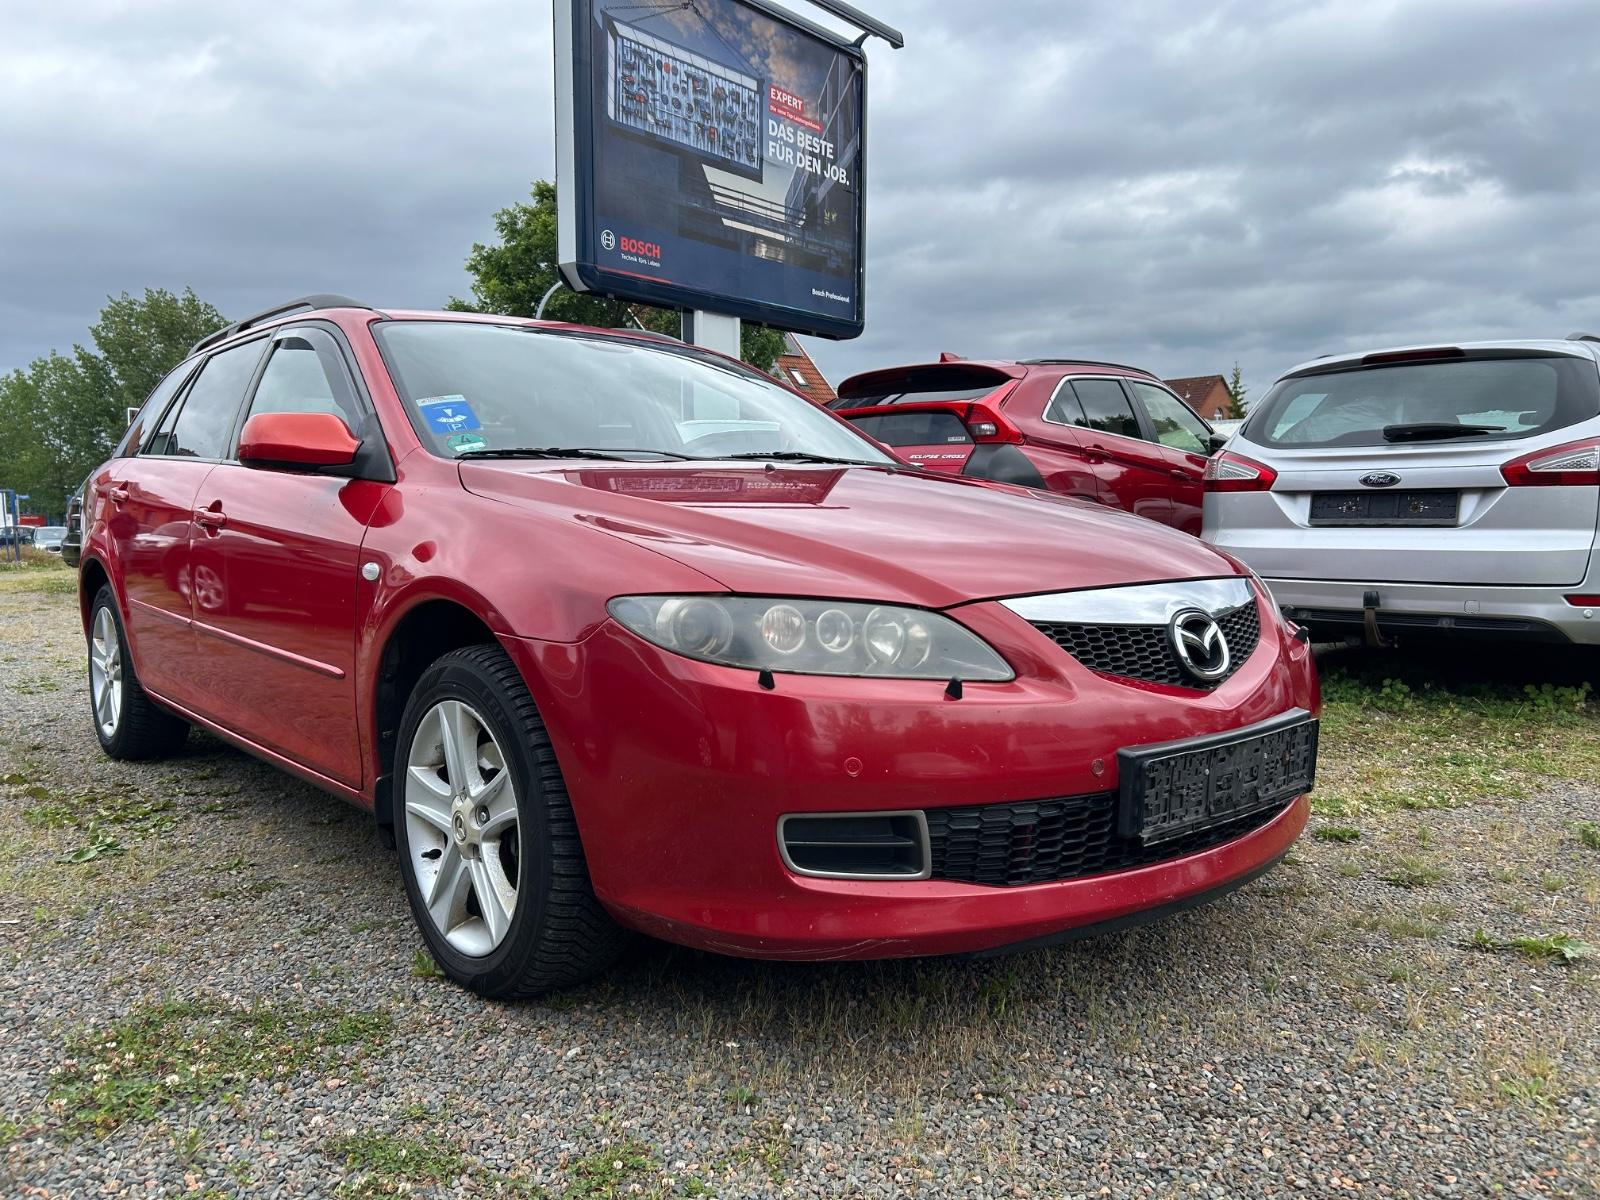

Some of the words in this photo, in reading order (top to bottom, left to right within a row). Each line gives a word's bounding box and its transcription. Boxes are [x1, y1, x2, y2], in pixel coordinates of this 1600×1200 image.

[770, 87, 803, 111] EXPERT
[768, 118, 794, 144] DAS
[797, 130, 834, 159] BESTE
[768, 140, 794, 166] FÜR
[796, 151, 821, 175] DEN
[823, 162, 850, 186] JOB.
[620, 235, 661, 259] BOSCH
[620, 252, 638, 263] Technik
[638, 255, 648, 265] fürs
[647, 259, 661, 268] Leben
[811, 288, 826, 297] Bosch
[1367, 474, 1391, 484] Ford
